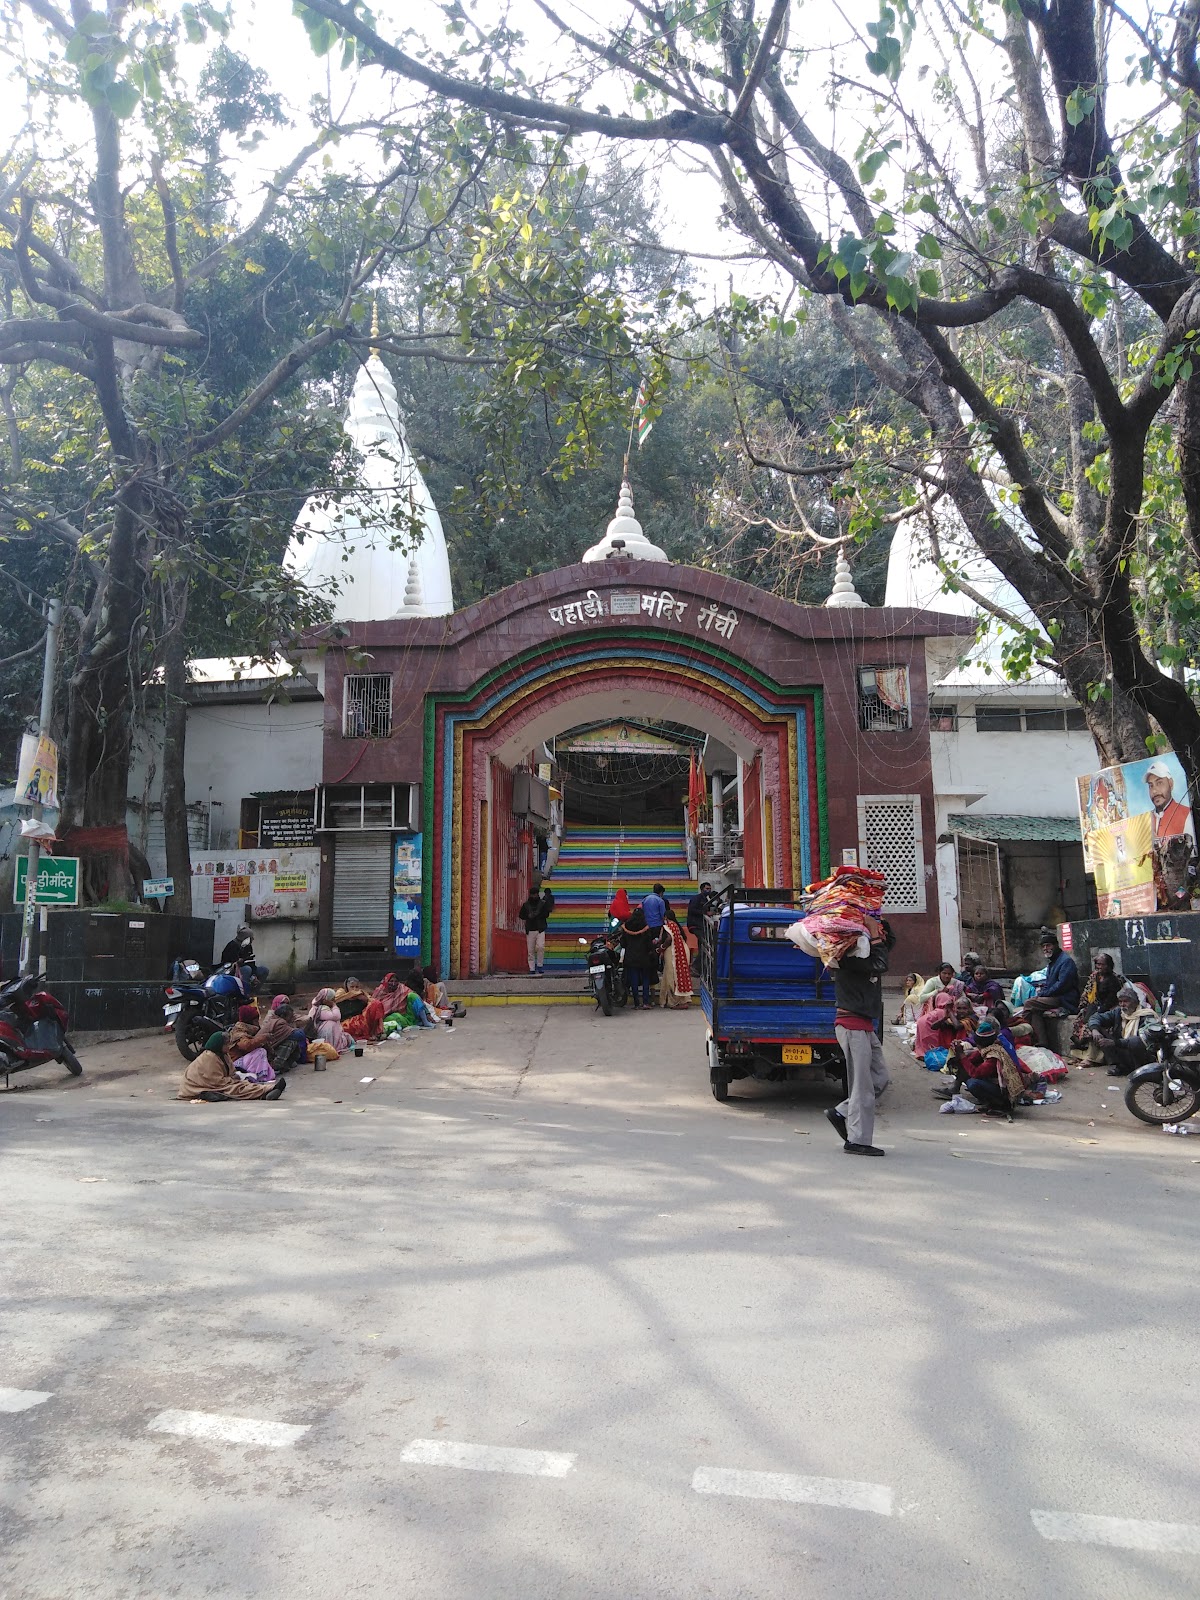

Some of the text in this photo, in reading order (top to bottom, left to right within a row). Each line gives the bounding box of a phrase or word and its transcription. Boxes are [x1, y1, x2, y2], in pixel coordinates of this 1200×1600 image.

[641, 590, 687, 622] मंदिर
[20, 870, 74, 890] पड़ी मंदिर
[395, 909, 420, 921] Bank
[402, 922, 413, 934] of
[395, 936, 419, 946] India
